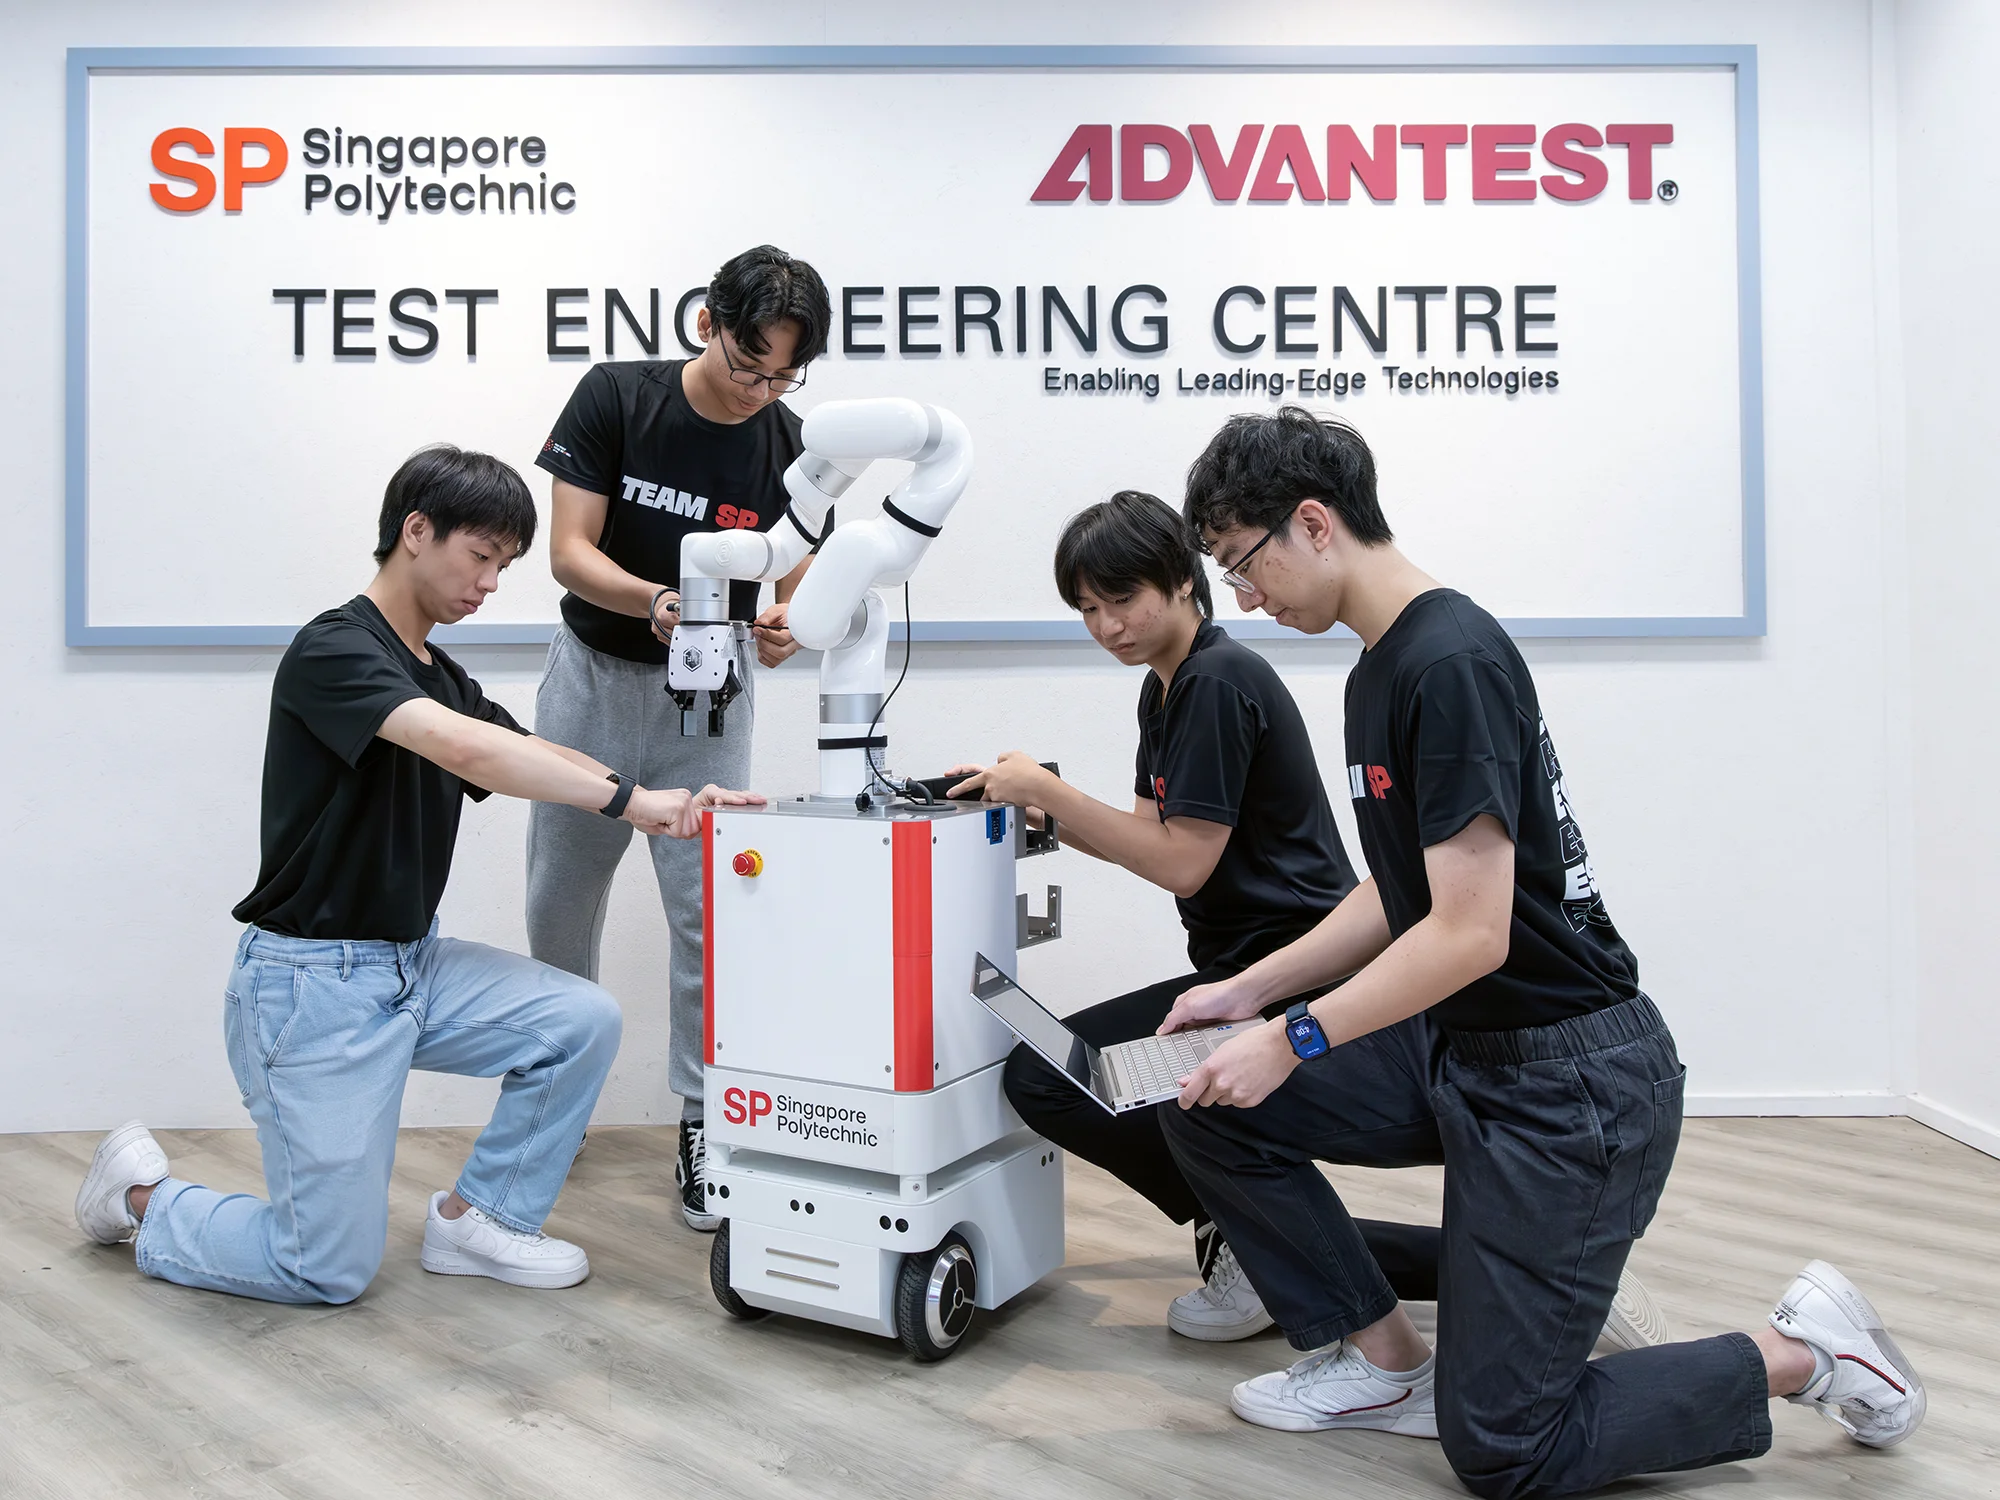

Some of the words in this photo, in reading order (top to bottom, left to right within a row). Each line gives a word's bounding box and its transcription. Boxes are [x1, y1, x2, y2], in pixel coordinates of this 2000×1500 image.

[149, 127, 289, 212] SP
[303, 127, 546, 176] Singapore
[305, 172, 576, 222] Polytechnic
[273, 287, 499, 358] TEST
[1213, 285, 1558, 354] CENTRE
[1044, 367, 1160, 398] Enabling
[1178, 367, 1366, 397] Leading-Edge
[1382, 365, 1559, 395] Technologies
[622, 475, 709, 521] TEAM
[715, 503, 759, 530] SP
[1366, 763, 1393, 800] SP
[723, 1087, 773, 1127] SP
[776, 1094, 867, 1124] Singapore
[777, 1114, 878, 1148] Polytechnic
